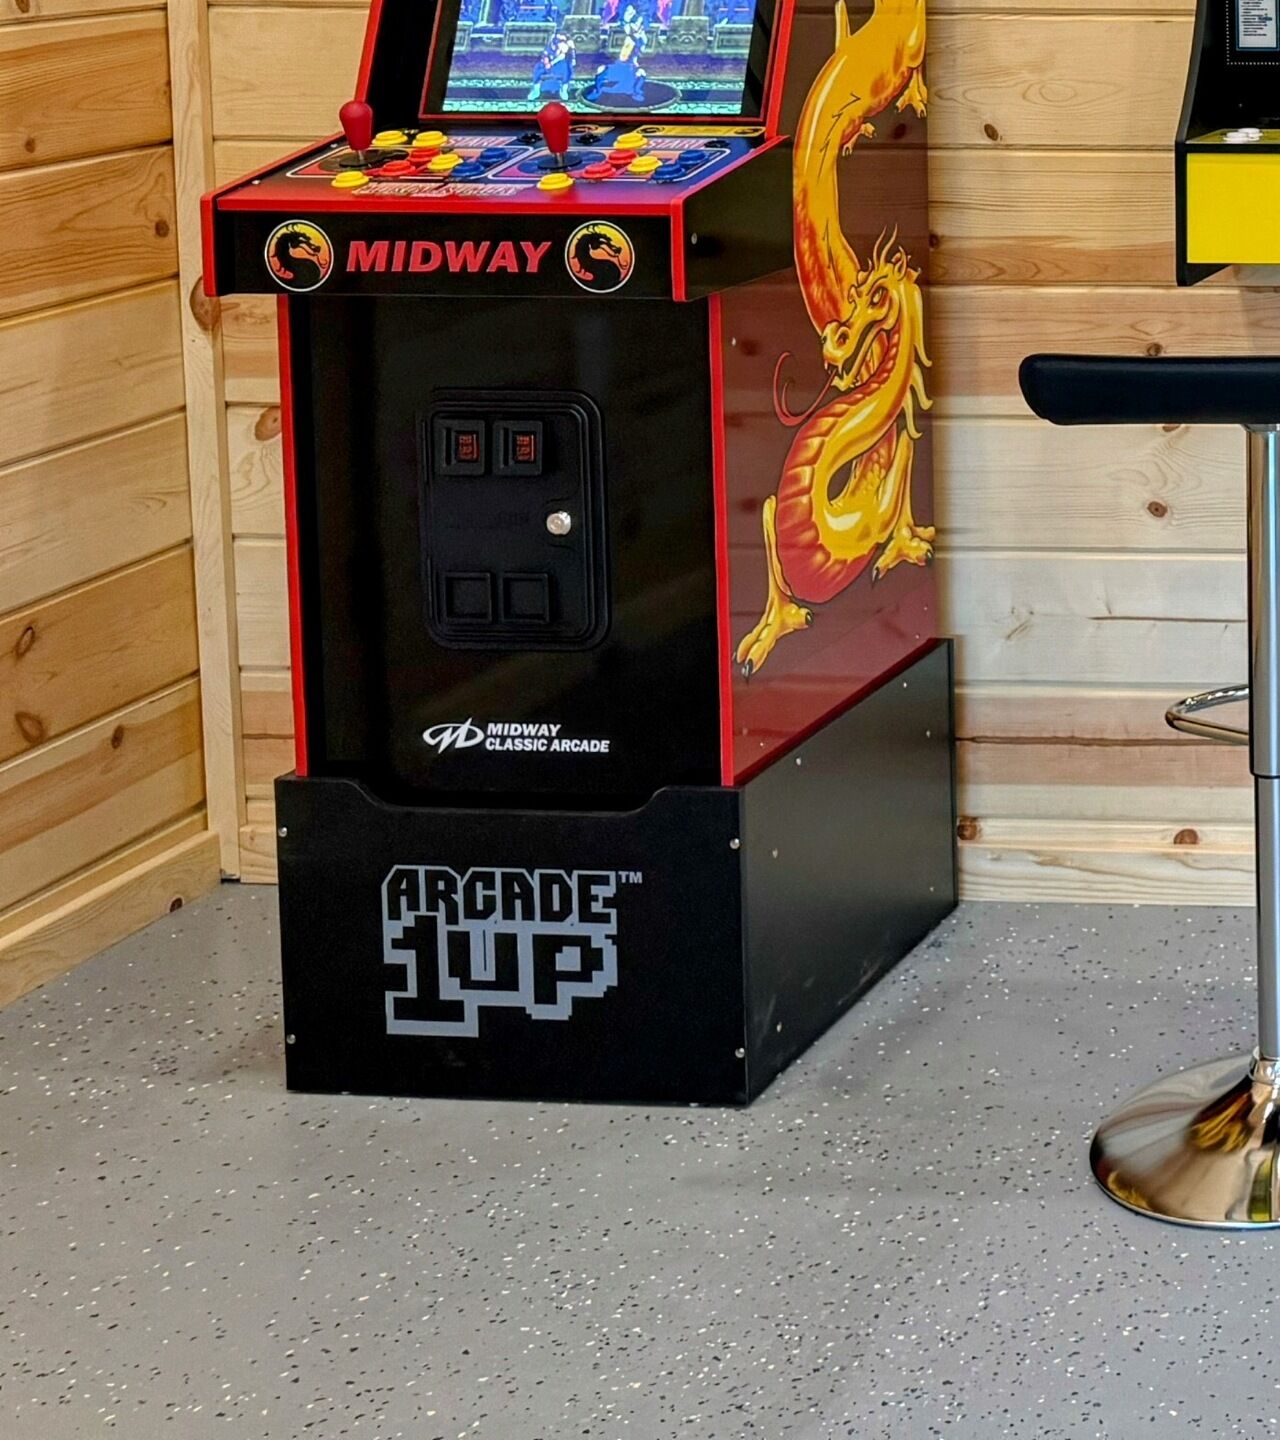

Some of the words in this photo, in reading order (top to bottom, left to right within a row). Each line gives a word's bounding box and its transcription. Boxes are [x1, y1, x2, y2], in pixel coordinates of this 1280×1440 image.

[345, 240, 553, 273] MIDWAY
[485, 738, 548, 751] CLASSIC
[550, 739, 610, 753] ARCADE
[486, 722, 561, 737] MIDWAY
[381, 864, 618, 925] ARCADE
[383, 914, 618, 1038] 1UP
